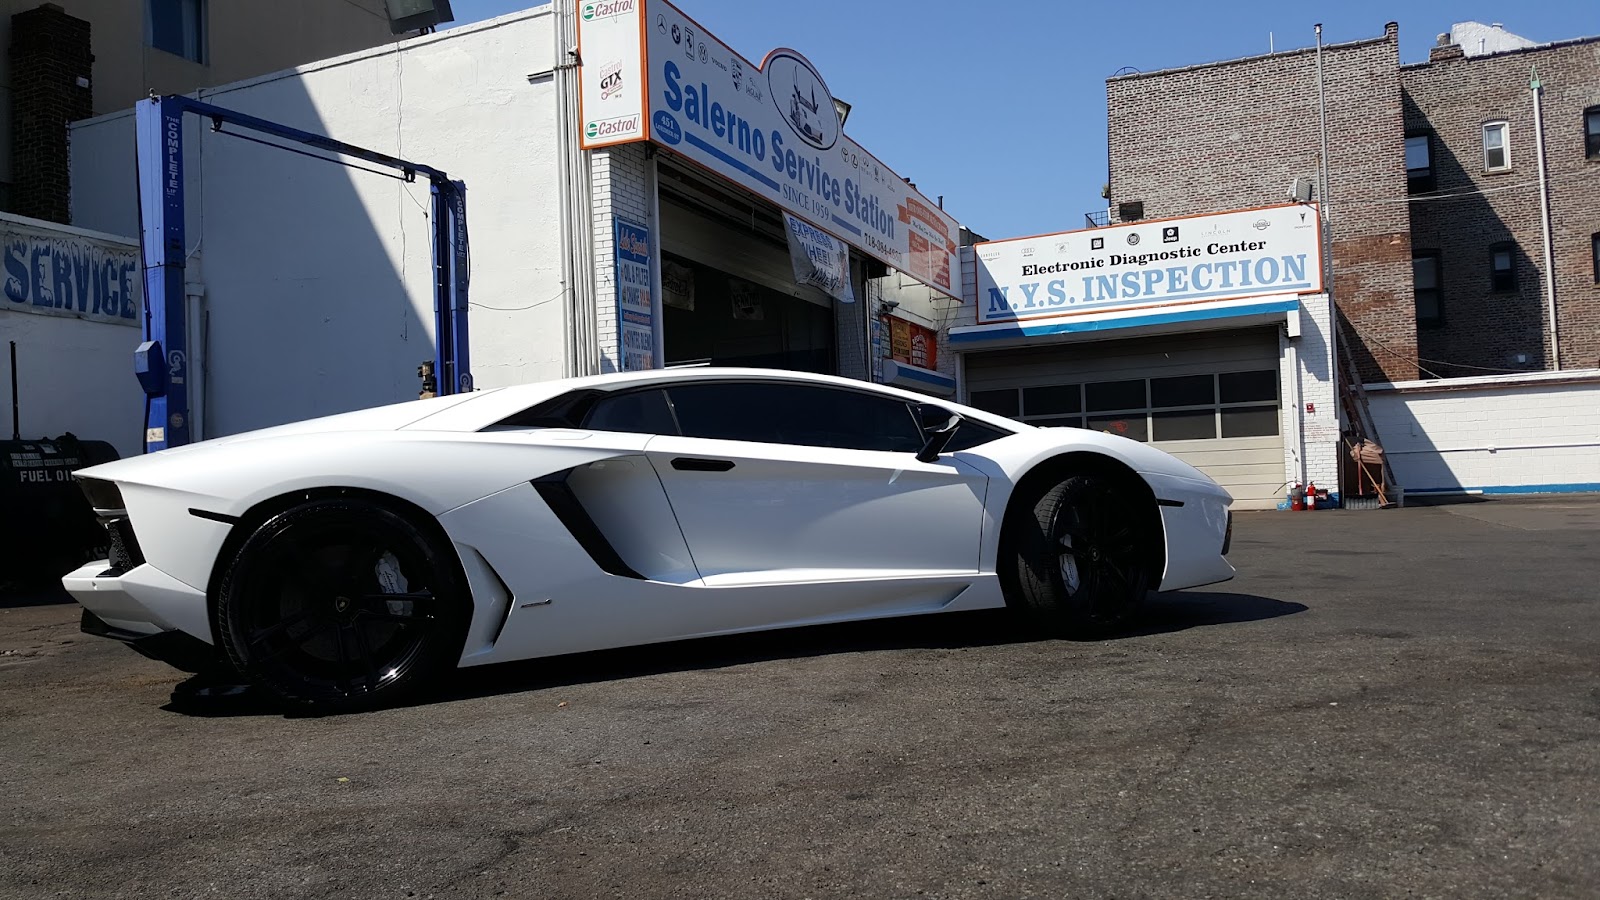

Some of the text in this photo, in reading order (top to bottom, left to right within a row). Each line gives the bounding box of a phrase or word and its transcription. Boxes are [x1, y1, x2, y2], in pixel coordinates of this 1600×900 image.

[595, 0, 633, 17] Castrol
[600, 69, 622, 90] GTX
[598, 116, 637, 136] Castrol
[660, 115, 674, 130] 451
[167, 122, 179, 189] COMPLETE
[663, 60, 766, 162] Salerno
[772, 129, 840, 207] Service
[845, 178, 895, 241] Station
[782, 183, 830, 221] SINCE 1959
[789, 216, 834, 251] EXPRESS
[4, 230, 137, 320] SERVICE
[624, 263, 632, 283] OIL
[1022, 240, 1267, 276] Electronic Diagnostic Center
[988, 253, 1307, 312] N.Y.S. INSPECTION
[20, 470, 52, 483] FUEL
